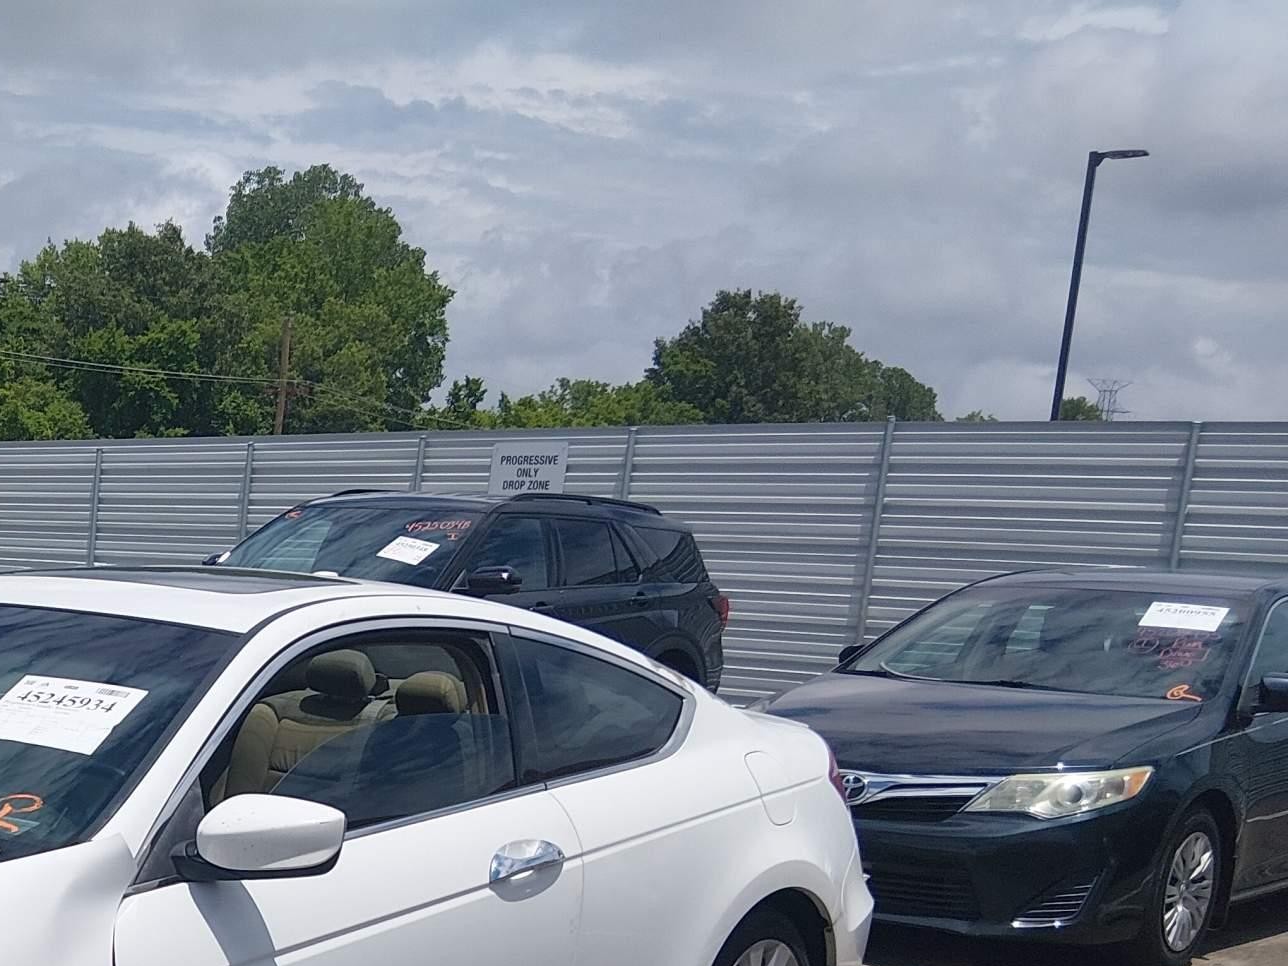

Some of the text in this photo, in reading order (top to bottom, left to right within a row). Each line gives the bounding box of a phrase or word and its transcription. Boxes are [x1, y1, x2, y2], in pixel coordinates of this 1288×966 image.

[500, 455, 559, 465] PROGRESSIVE
[516, 468, 540, 478] ONLY
[502, 480, 550, 490] DROP ZONE
[16, 690, 118, 713] 45245934
